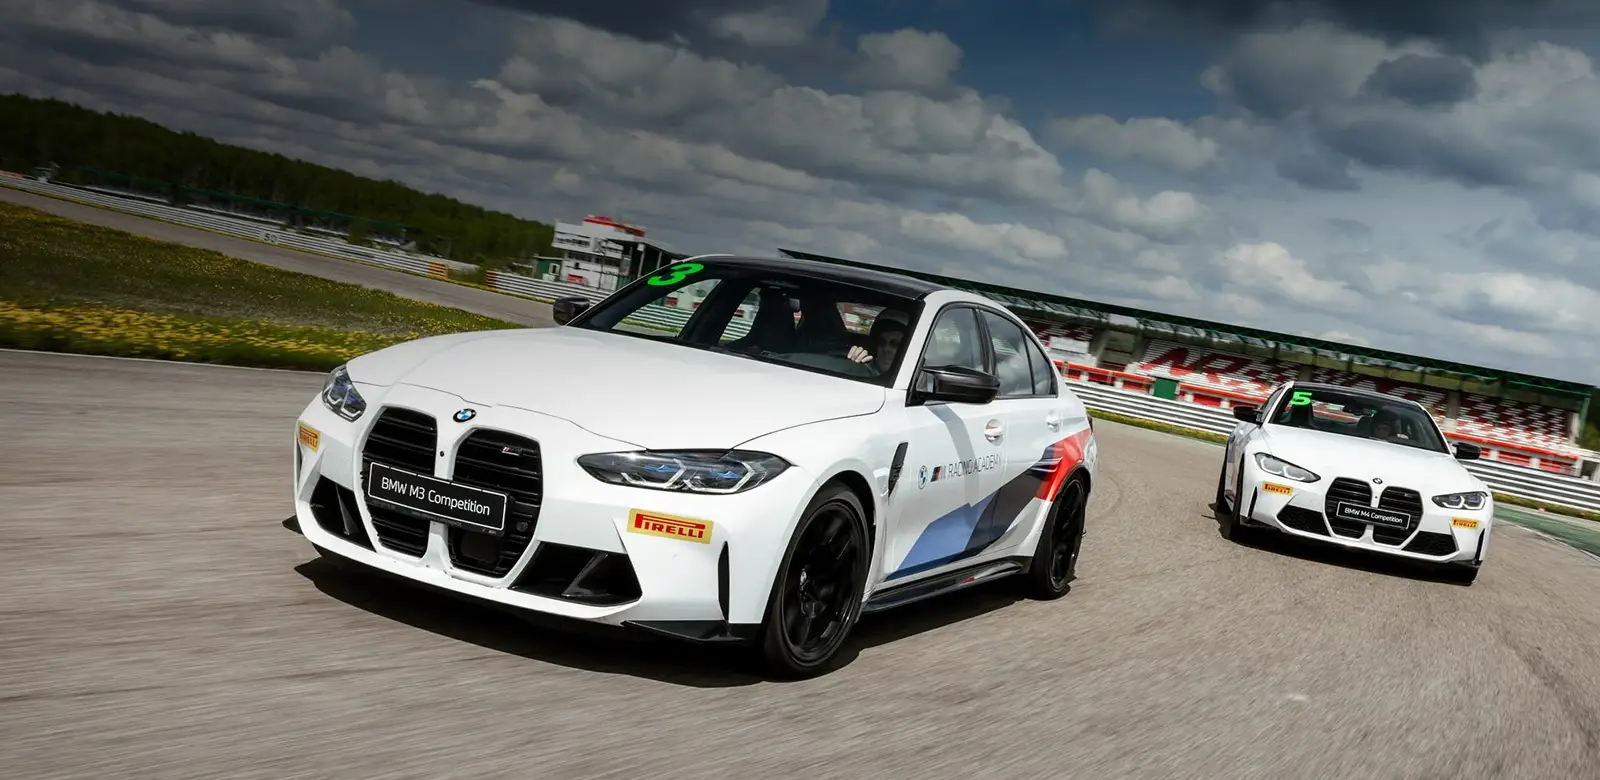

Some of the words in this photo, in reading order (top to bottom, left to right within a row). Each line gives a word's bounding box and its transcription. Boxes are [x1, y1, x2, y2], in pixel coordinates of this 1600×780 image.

[647, 263, 704, 286] 3
[1289, 391, 1312, 405] 5
[381, 476, 408, 495] BMW
[410, 484, 425, 500] M3
[428, 489, 491, 516] Competition
[1264, 483, 1291, 494] PIRELLI
[634, 512, 706, 539] PIRELLI
[1344, 507, 1360, 516] BMW
[1360, 510, 1370, 518] M4
[1370, 512, 1403, 524] Competition
